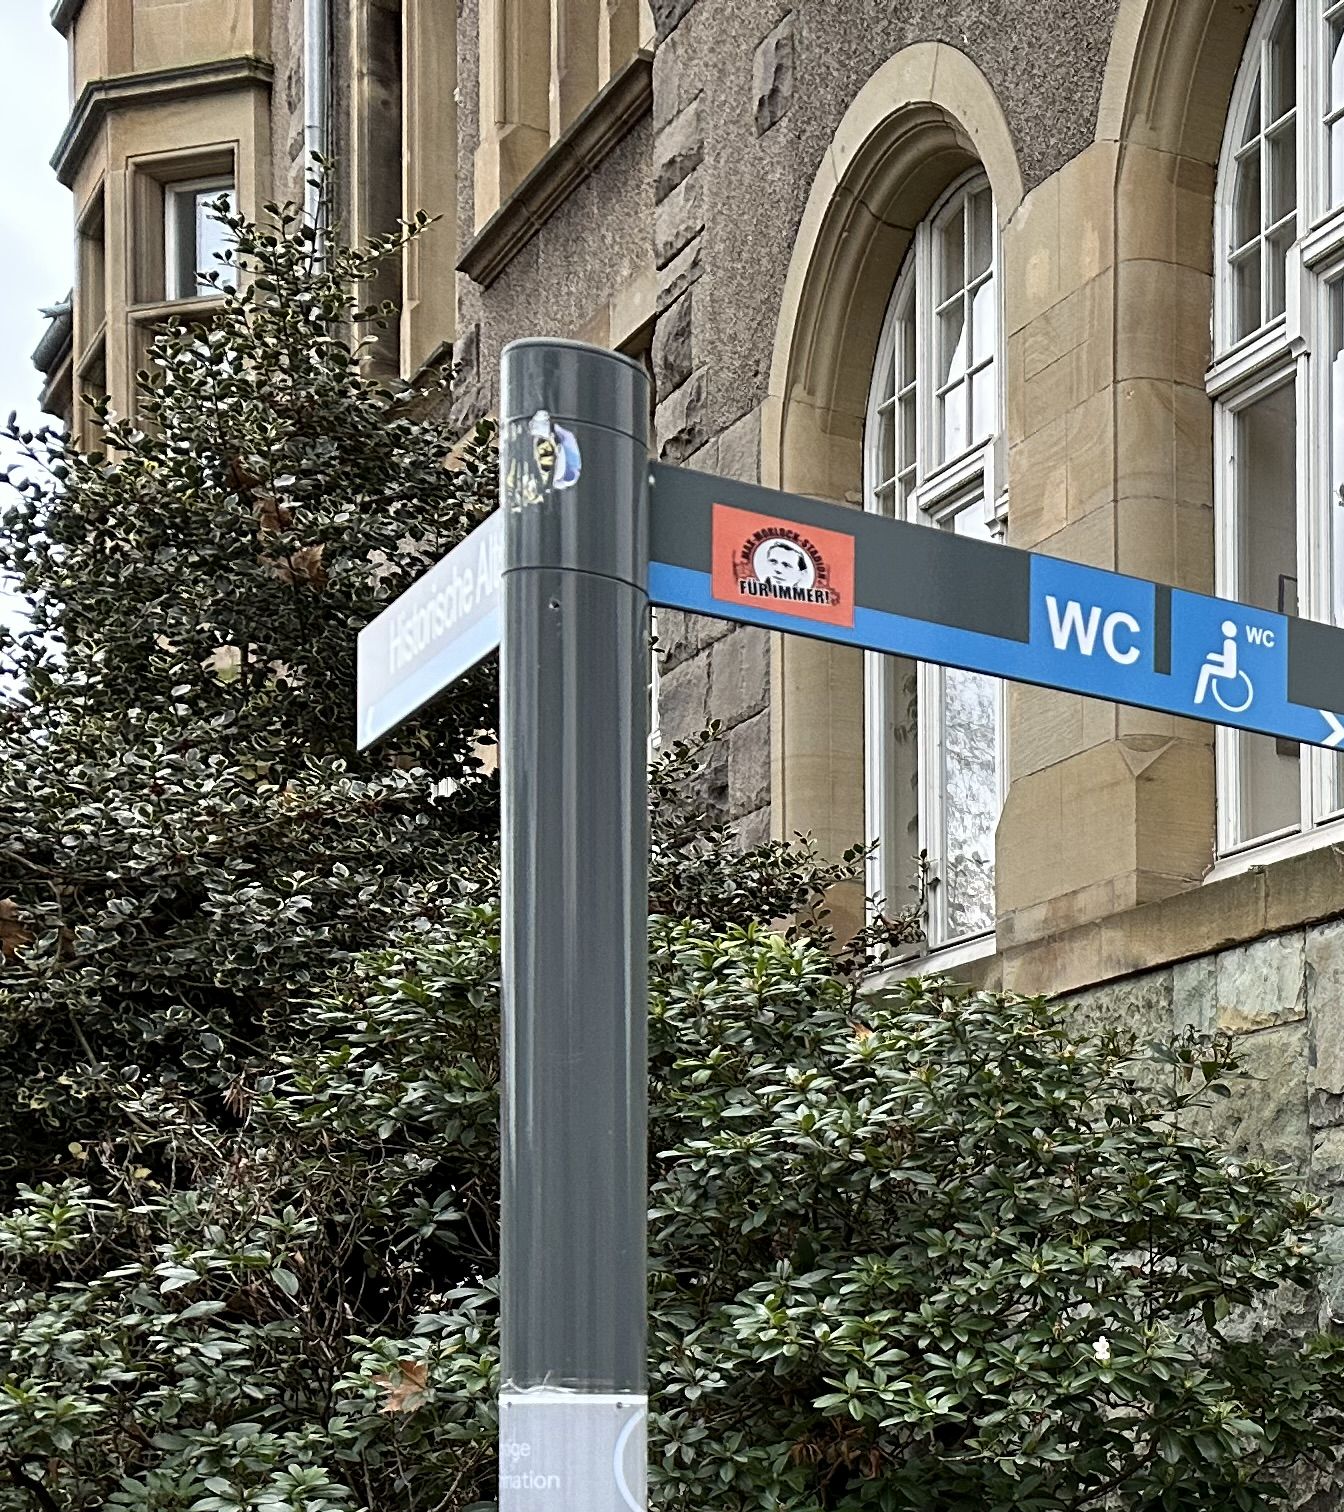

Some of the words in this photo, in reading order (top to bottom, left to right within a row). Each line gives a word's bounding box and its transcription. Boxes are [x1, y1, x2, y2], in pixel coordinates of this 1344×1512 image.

[739, 578, 769, 597] FÜR
[772, 585, 830, 604] IMMER!
[388, 565, 474, 675] Historische
[1045, 595, 1141, 665] WC
[1245, 625, 1276, 648] WC
